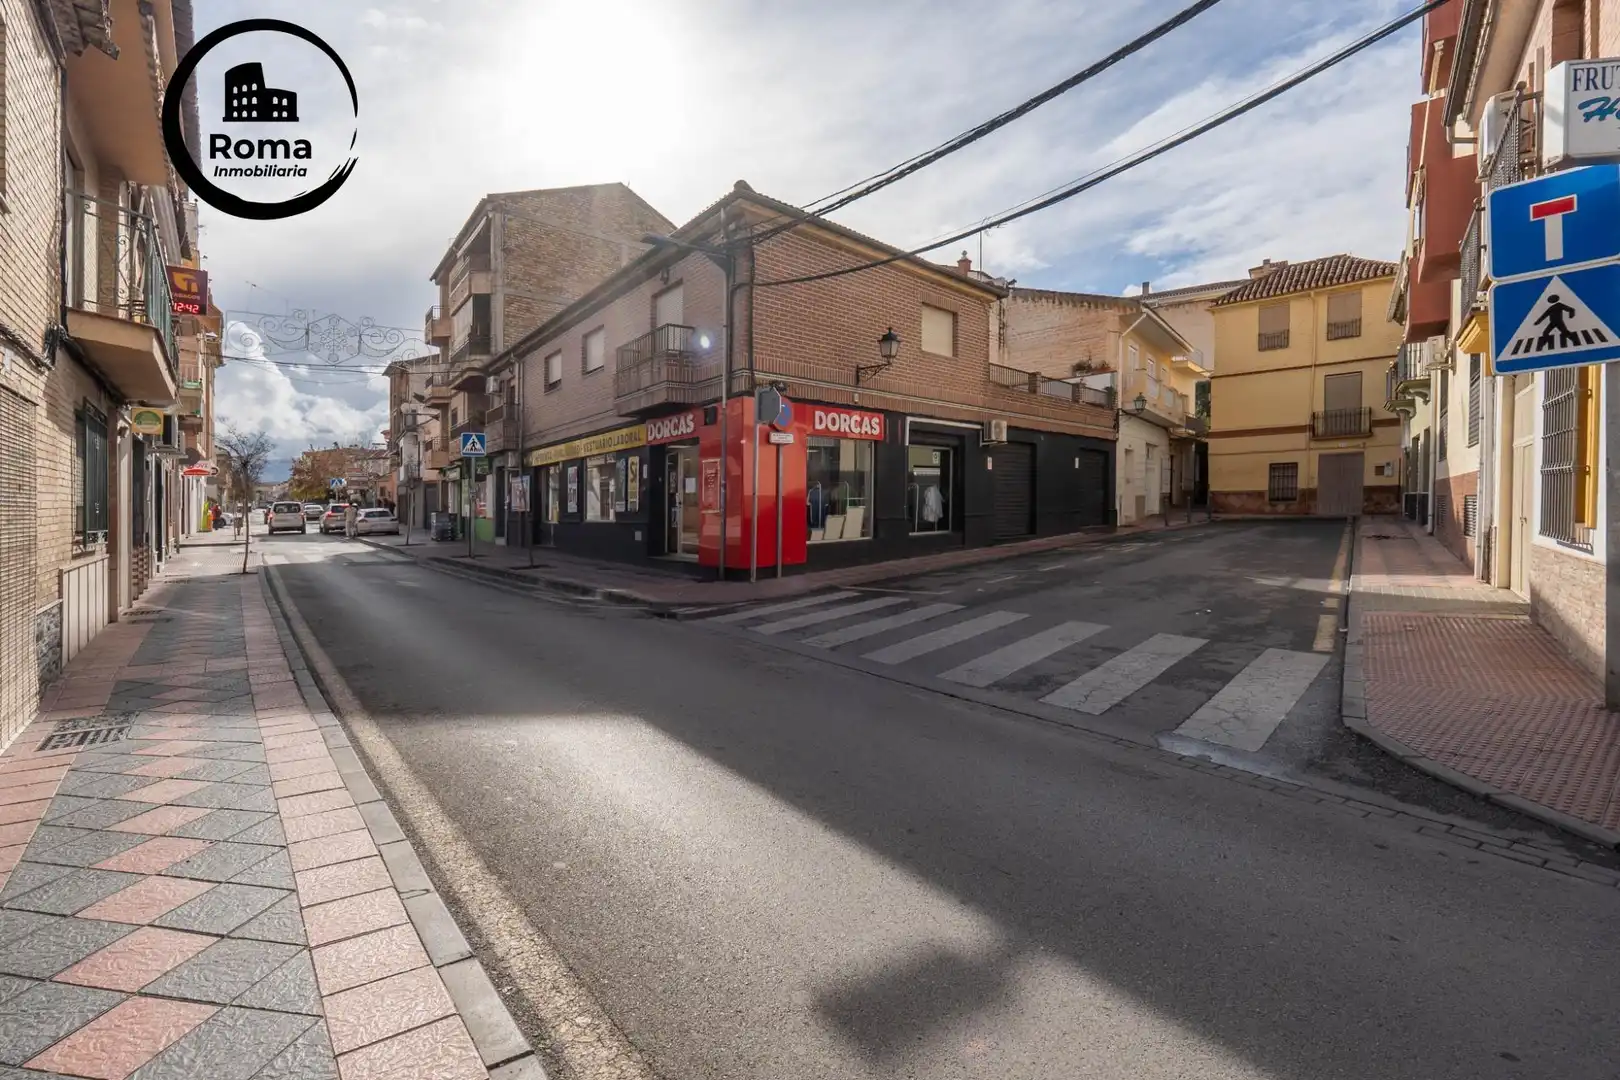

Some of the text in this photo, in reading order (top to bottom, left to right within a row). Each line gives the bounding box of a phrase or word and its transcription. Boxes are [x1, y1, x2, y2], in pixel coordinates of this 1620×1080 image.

[174, 302, 199, 314] 12:42
[648, 413, 695, 441] DORCAS
[815, 410, 880, 435] DORCAS
